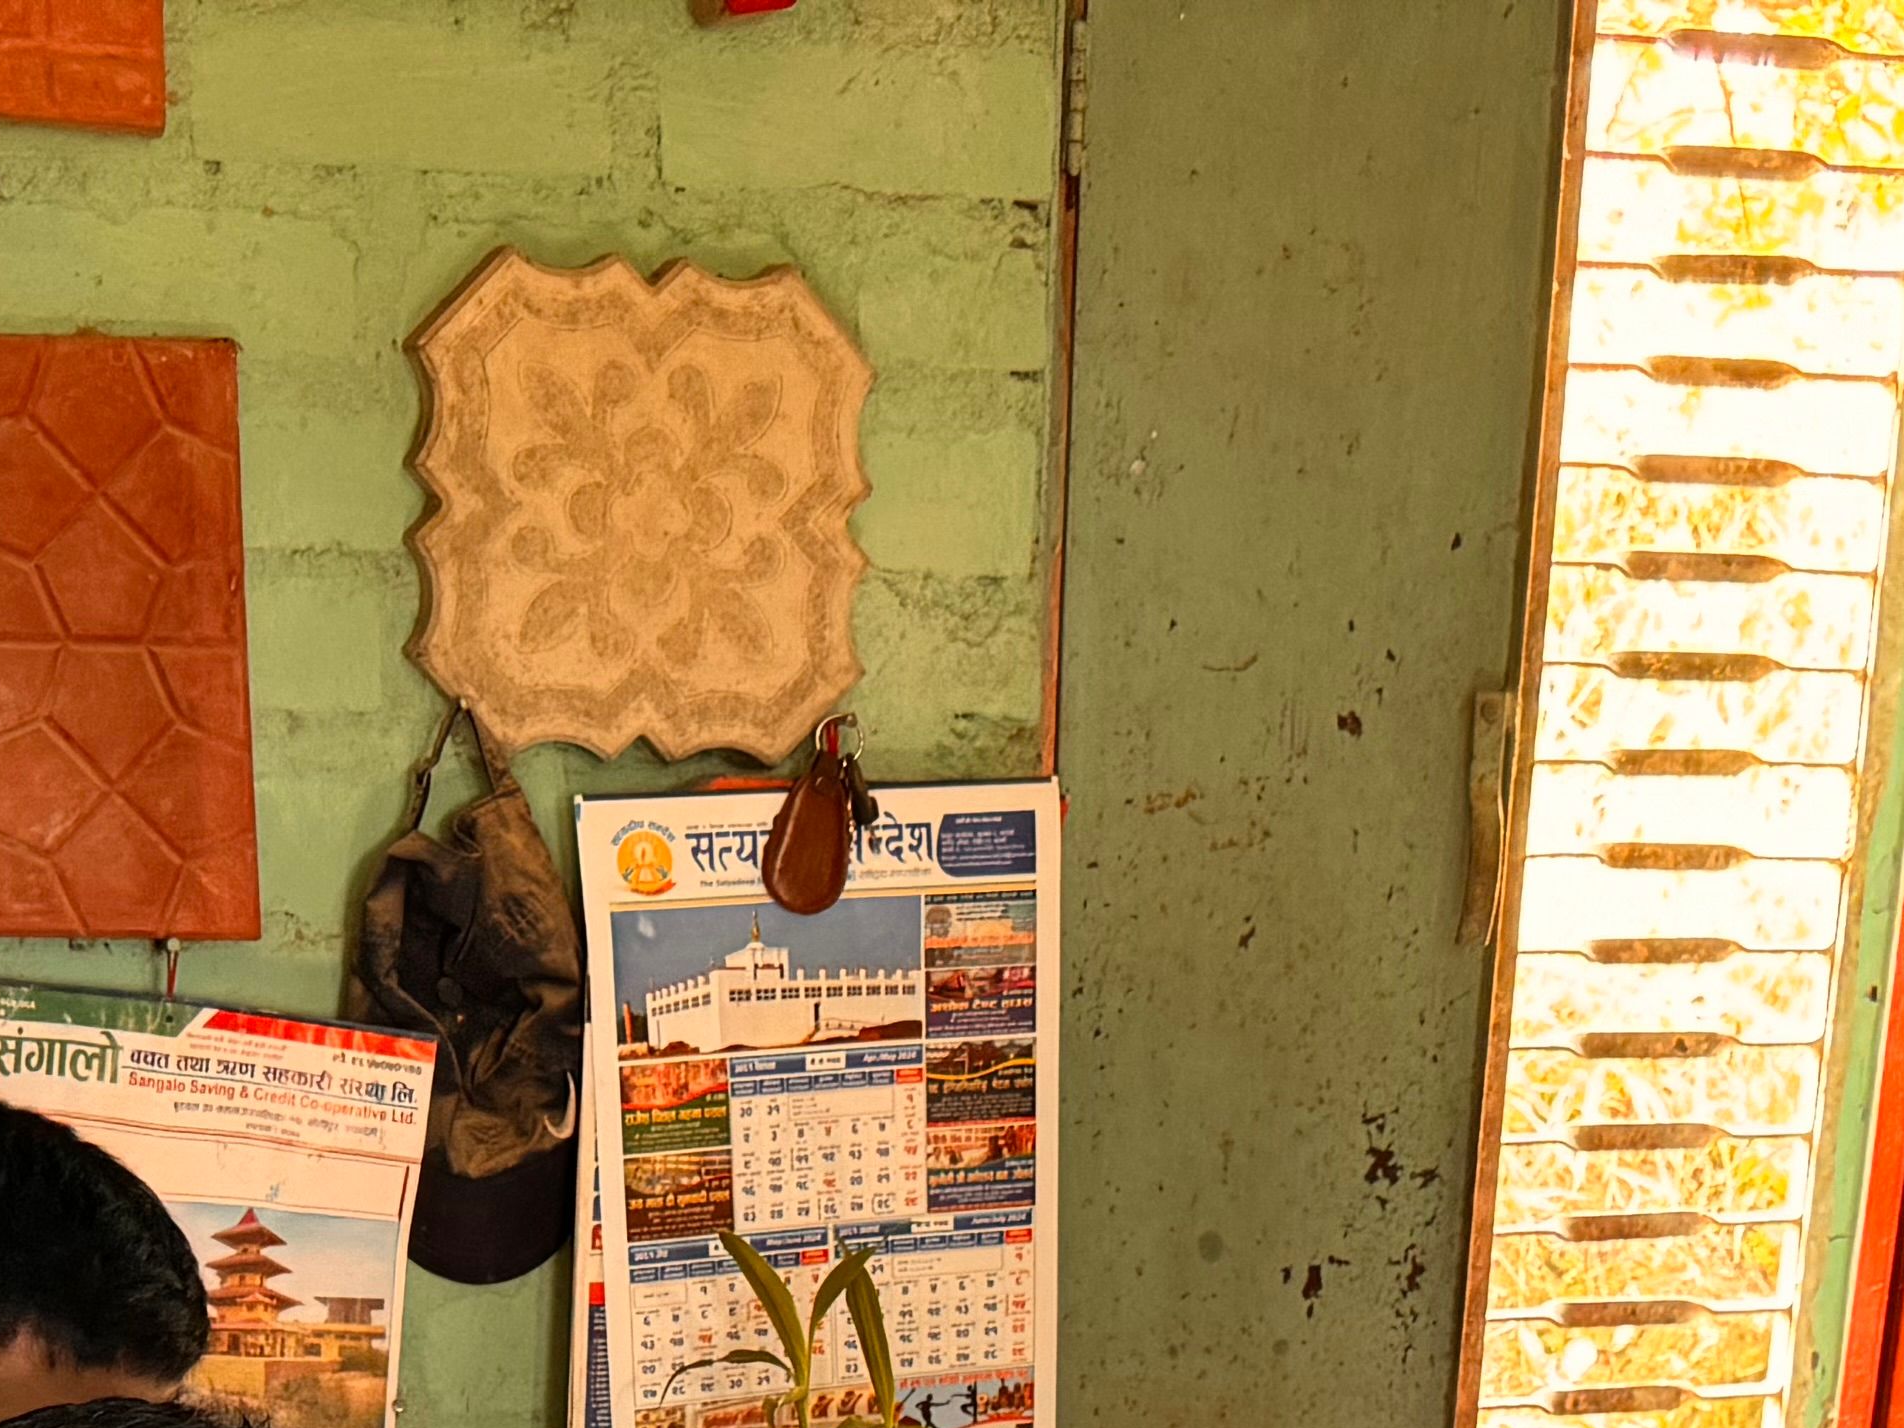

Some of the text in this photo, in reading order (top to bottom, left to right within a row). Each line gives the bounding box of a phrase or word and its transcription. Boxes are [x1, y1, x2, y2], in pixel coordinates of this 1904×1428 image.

[684, 824, 773, 873] सत्य
[128, 1072, 417, 1125] Sangalo Saving & Credit Co-operative Ltd.
[176, 1054, 210, 1074] तथा
[216, 1059, 255, 1079] ऋण
[263, 1065, 332, 1090] सहकारी
[391, 1081, 418, 1104] लि.
